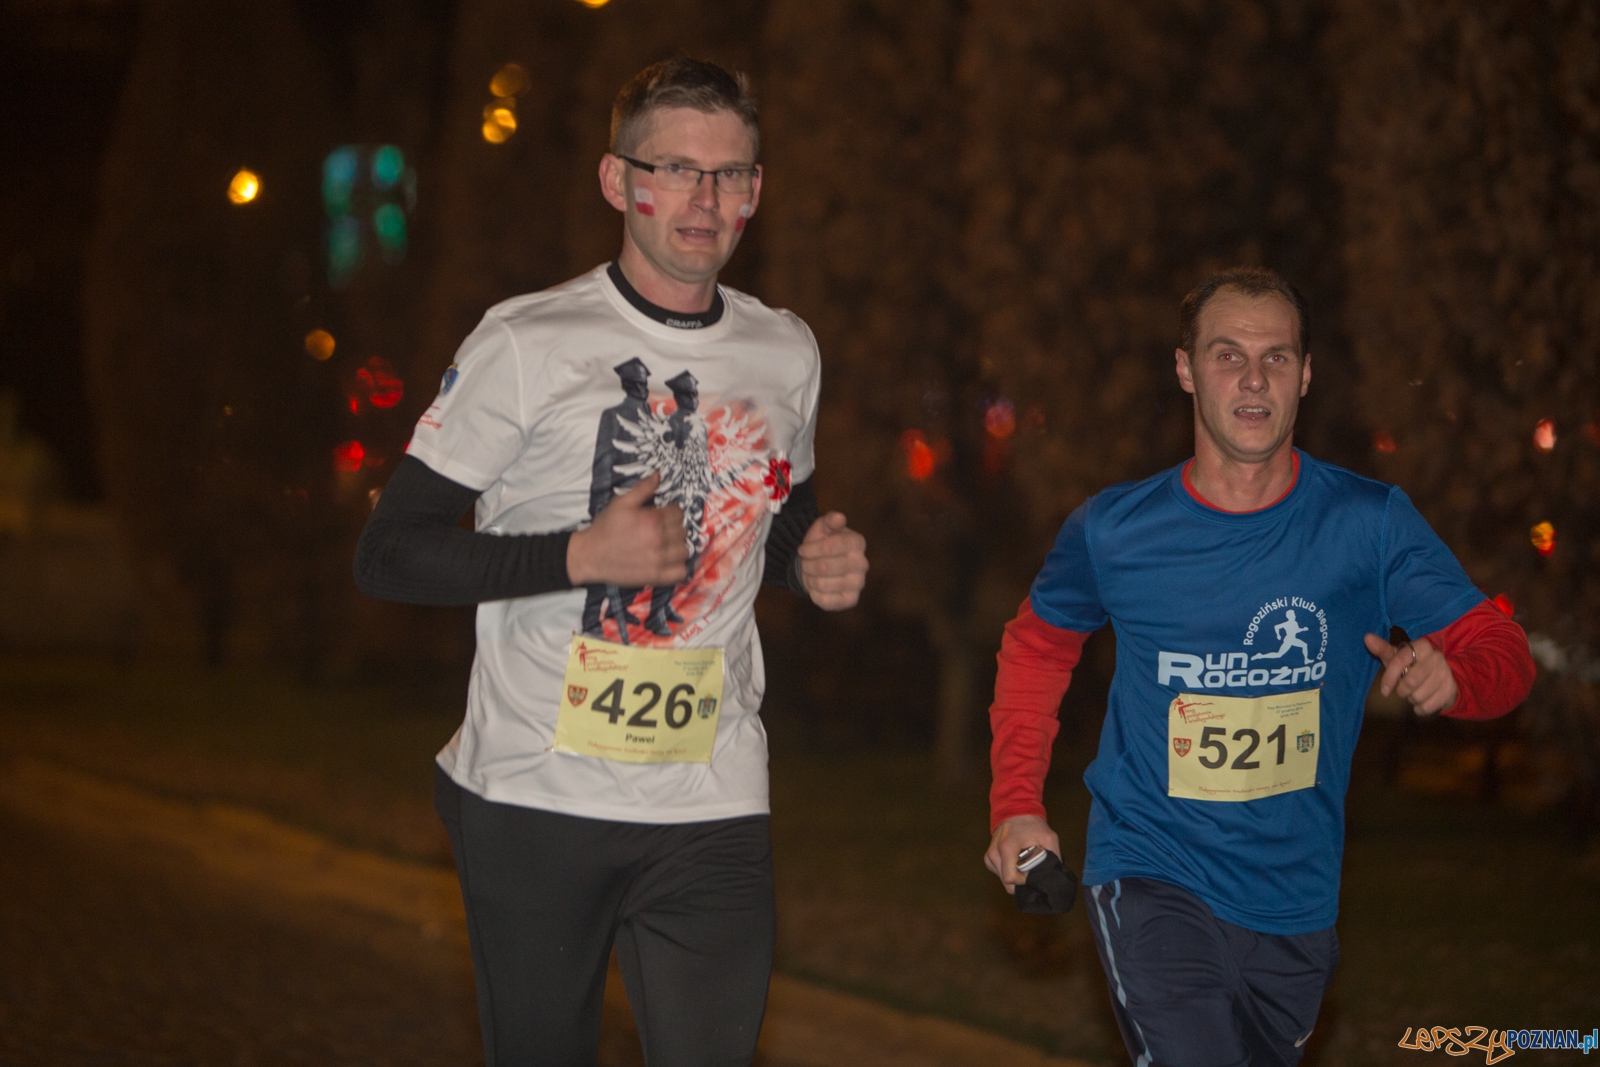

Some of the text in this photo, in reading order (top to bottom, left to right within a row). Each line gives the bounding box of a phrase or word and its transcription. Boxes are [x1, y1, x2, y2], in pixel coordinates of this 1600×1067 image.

[1243, 596, 1328, 661] Rogoziński Klub Biegacza
[591, 677, 696, 730] 426
[1198, 724, 1286, 770] 521
